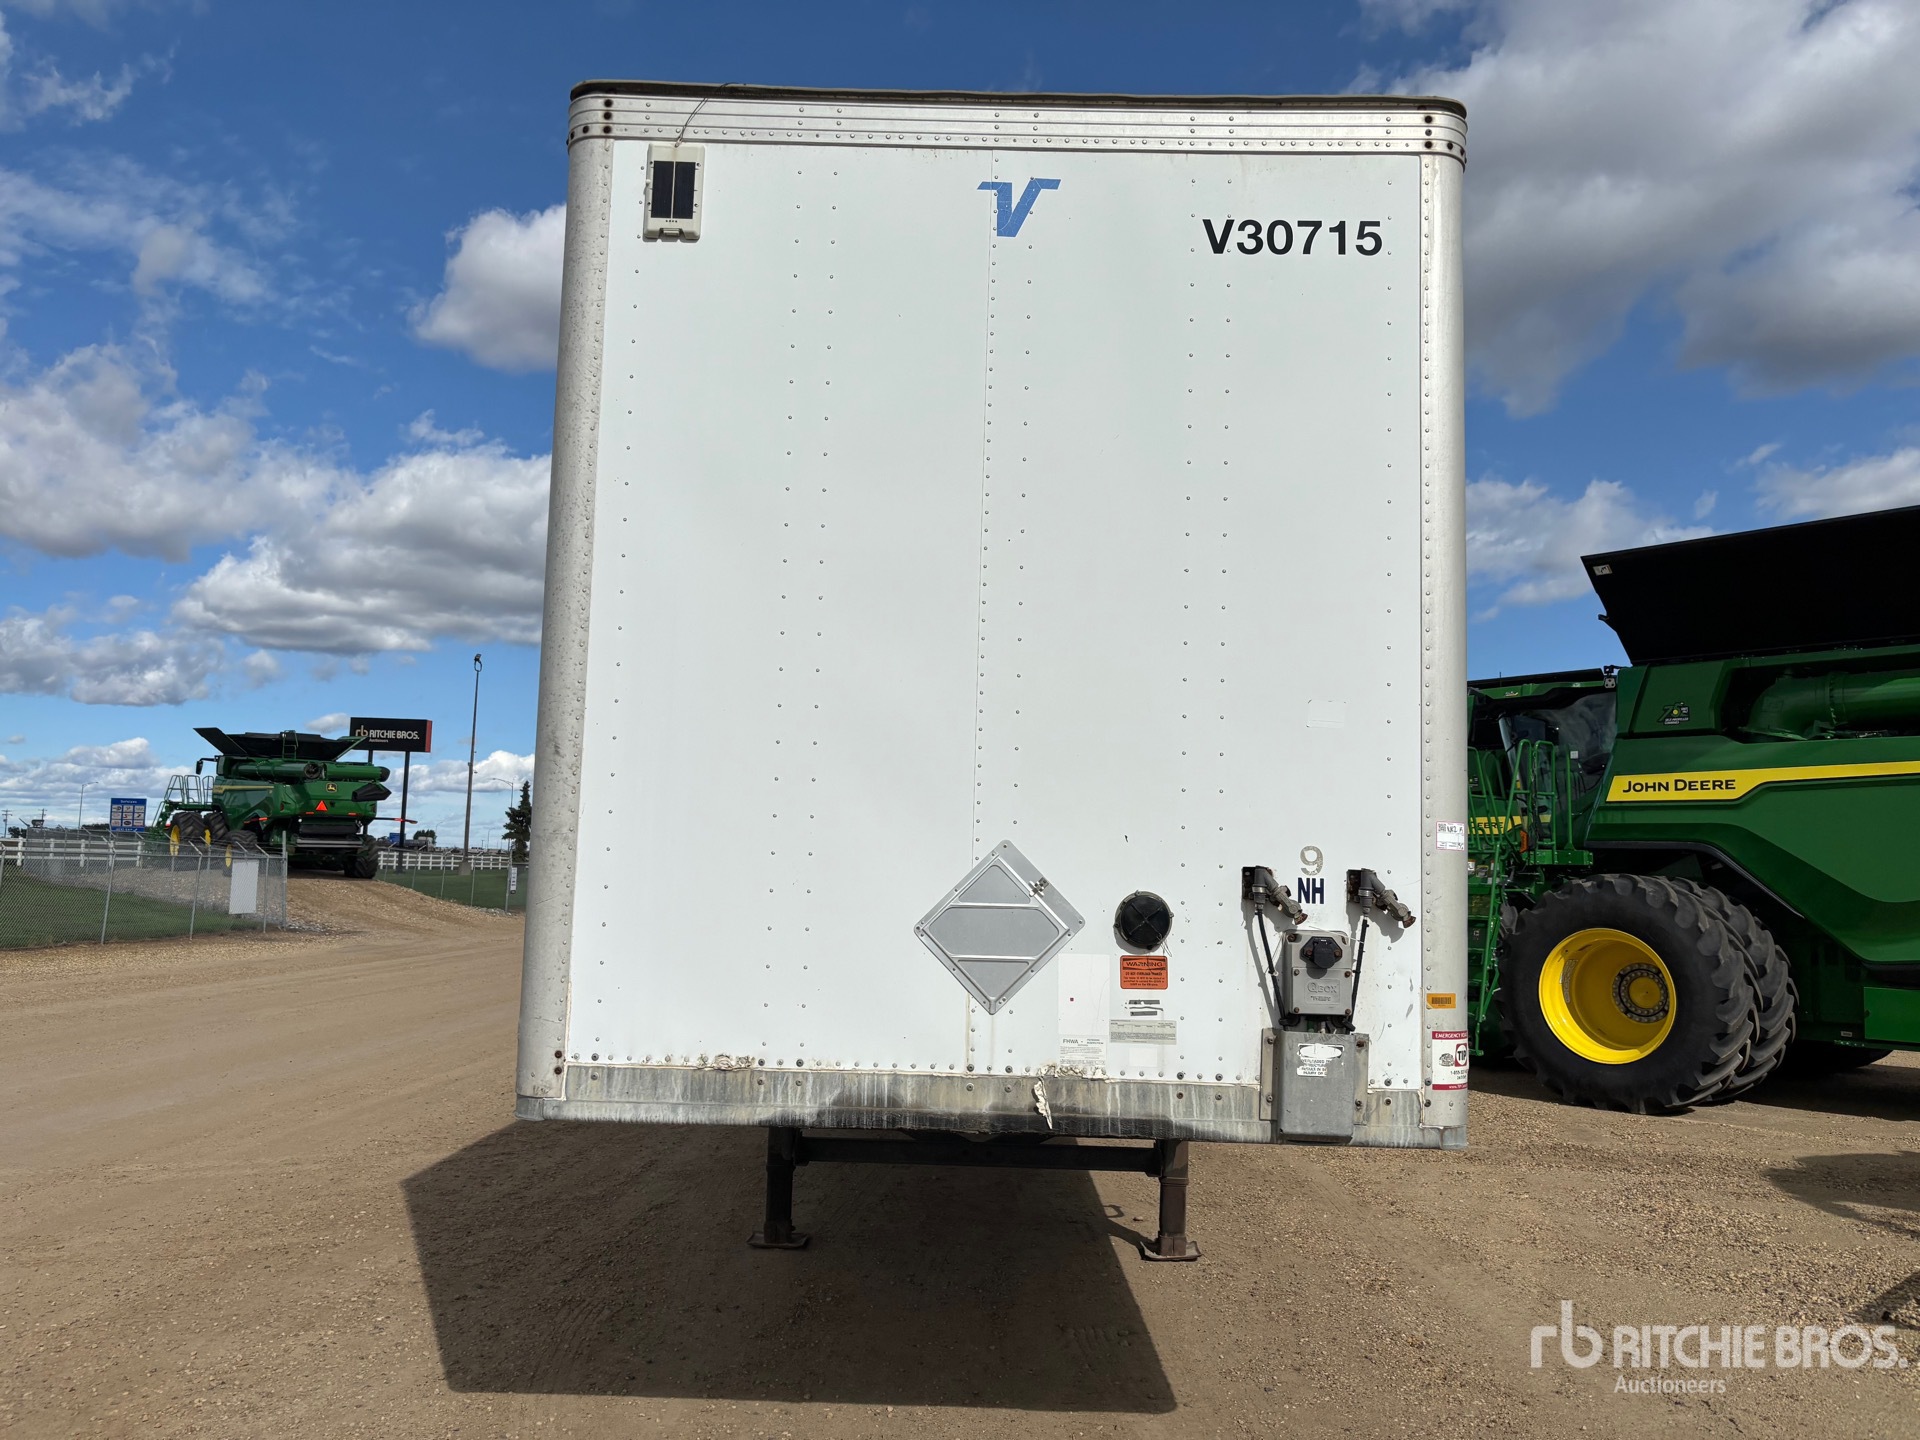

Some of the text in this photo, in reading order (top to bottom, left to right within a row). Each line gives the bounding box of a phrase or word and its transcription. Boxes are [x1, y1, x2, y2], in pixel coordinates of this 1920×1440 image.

[1202, 218, 1383, 256] V30715
[369, 729, 396, 739] RITCHIE
[396, 730, 420, 740] BROS.
[1622, 778, 1736, 793] JOHN DEERE
[1300, 845, 1324, 876] 9
[1297, 877, 1325, 904] NH
[1457, 1050, 1467, 1061] TIP
